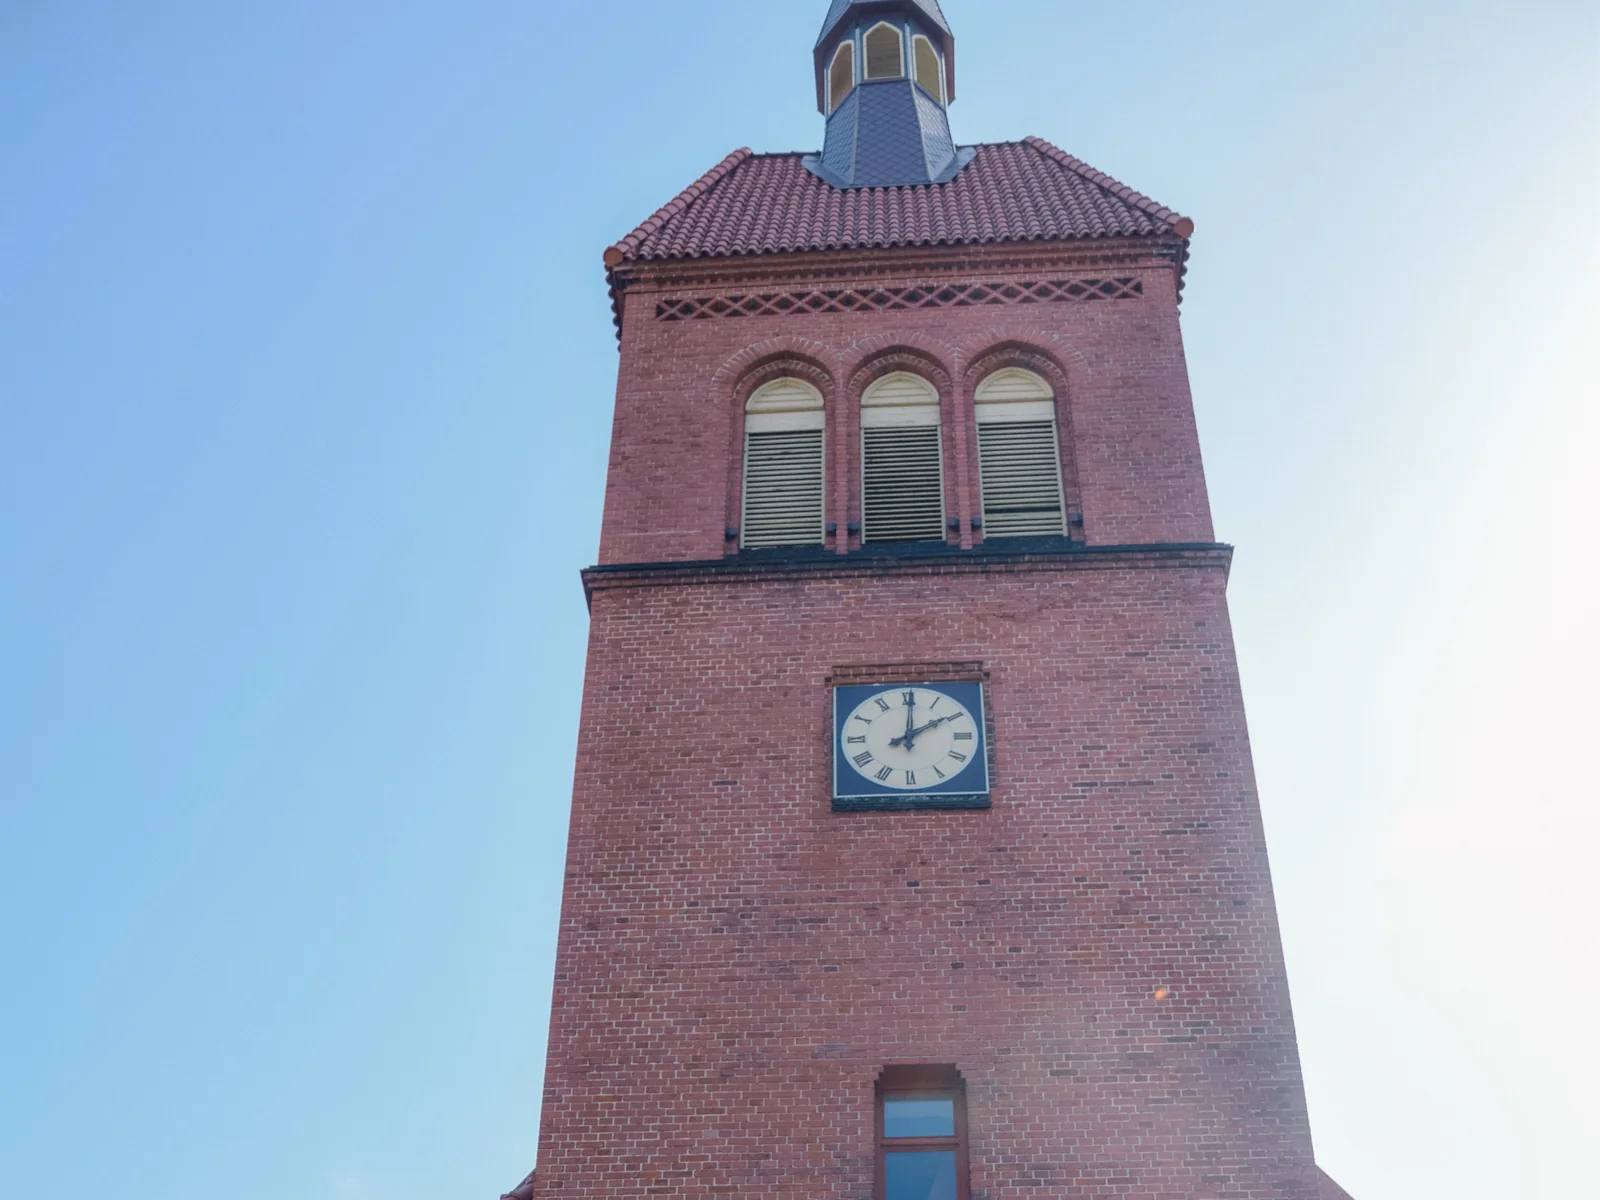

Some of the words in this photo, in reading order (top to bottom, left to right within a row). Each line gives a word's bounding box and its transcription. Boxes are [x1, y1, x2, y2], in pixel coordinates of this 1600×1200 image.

[930, 697, 941, 709] I
[854, 714, 872, 725] X
[947, 711, 964, 722] II
[954, 732, 972, 740] III
[852, 750, 874, 768] VIII
[874, 765, 893, 781] VII
[905, 770, 916, 785] VI
[932, 765, 945, 779] V
